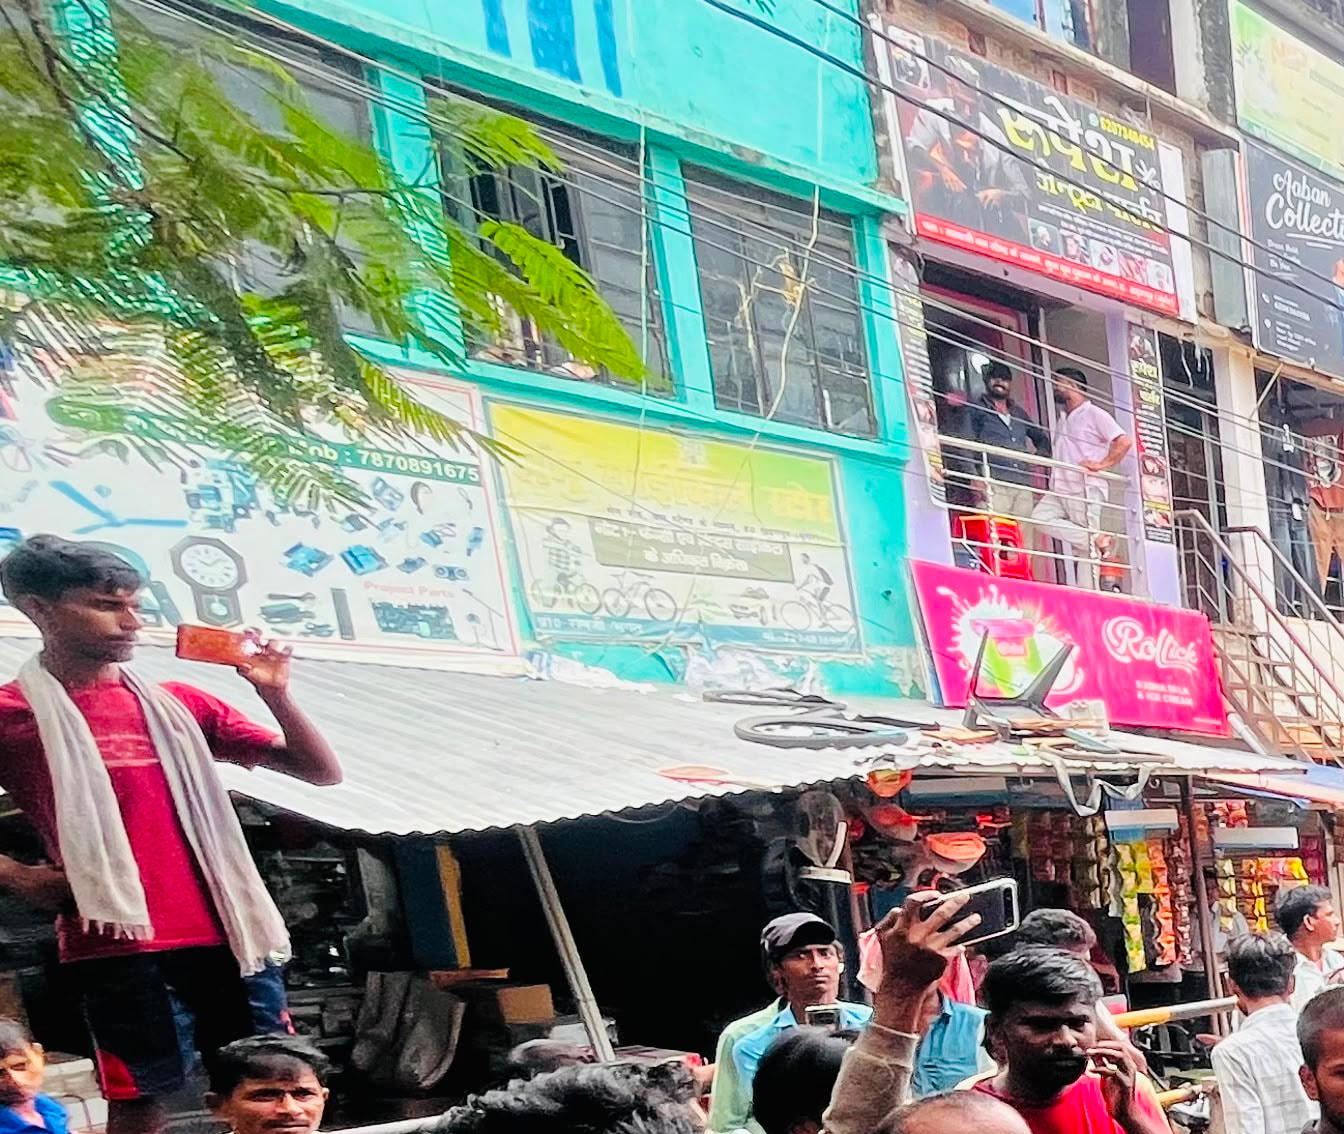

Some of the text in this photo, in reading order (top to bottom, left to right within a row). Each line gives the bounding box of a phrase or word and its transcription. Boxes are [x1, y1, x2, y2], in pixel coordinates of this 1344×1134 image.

[1272, 169, 1331, 209] Aaban
[360, 450, 481, 482] 7870891675
[1103, 615, 1199, 674] Rollick
